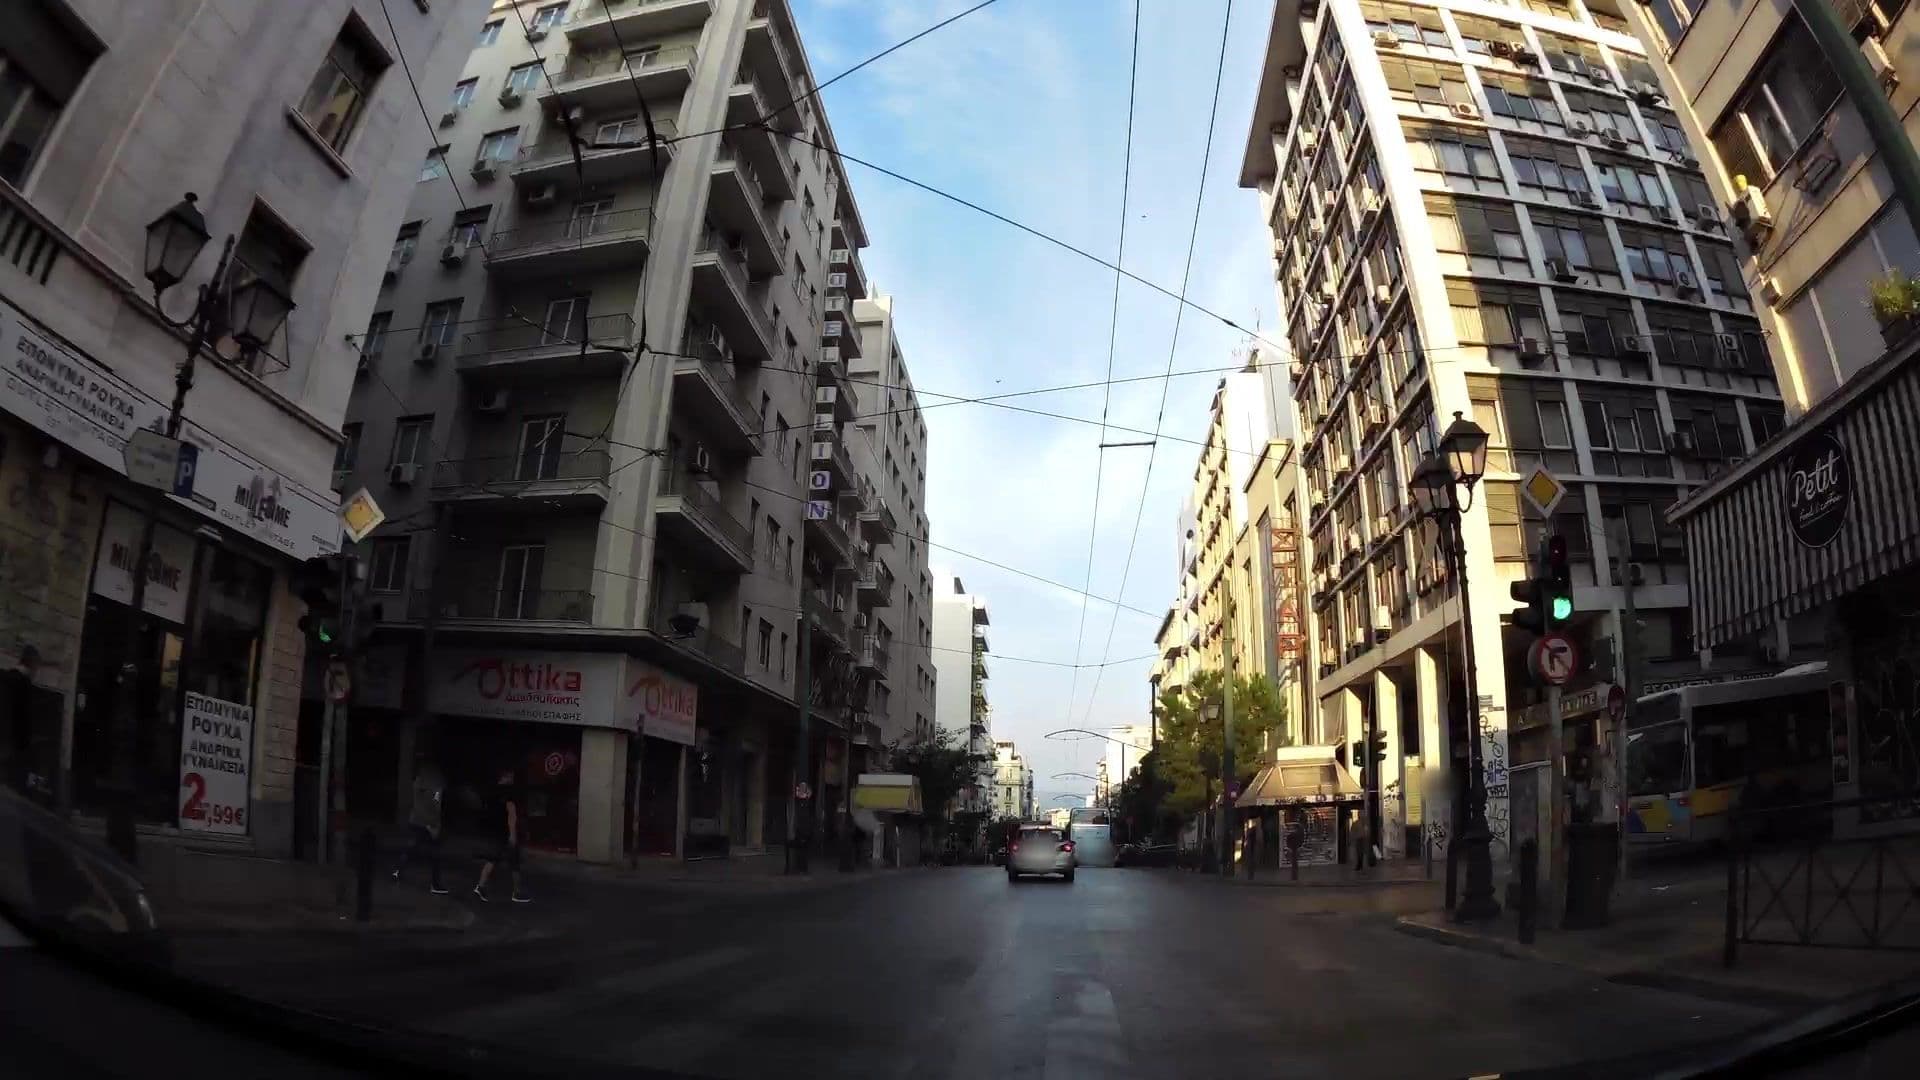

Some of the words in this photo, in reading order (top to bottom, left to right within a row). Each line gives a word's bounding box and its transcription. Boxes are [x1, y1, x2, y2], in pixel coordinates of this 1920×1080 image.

[89, 381, 135, 420] ΡΟΥΧΑ
[177, 461, 193, 486] P
[1790, 449, 1841, 508] Petit
[186, 695, 250, 722] ΕΠΩΝΥΜΑ
[191, 715, 242, 741] ΡΟΥΧΑ
